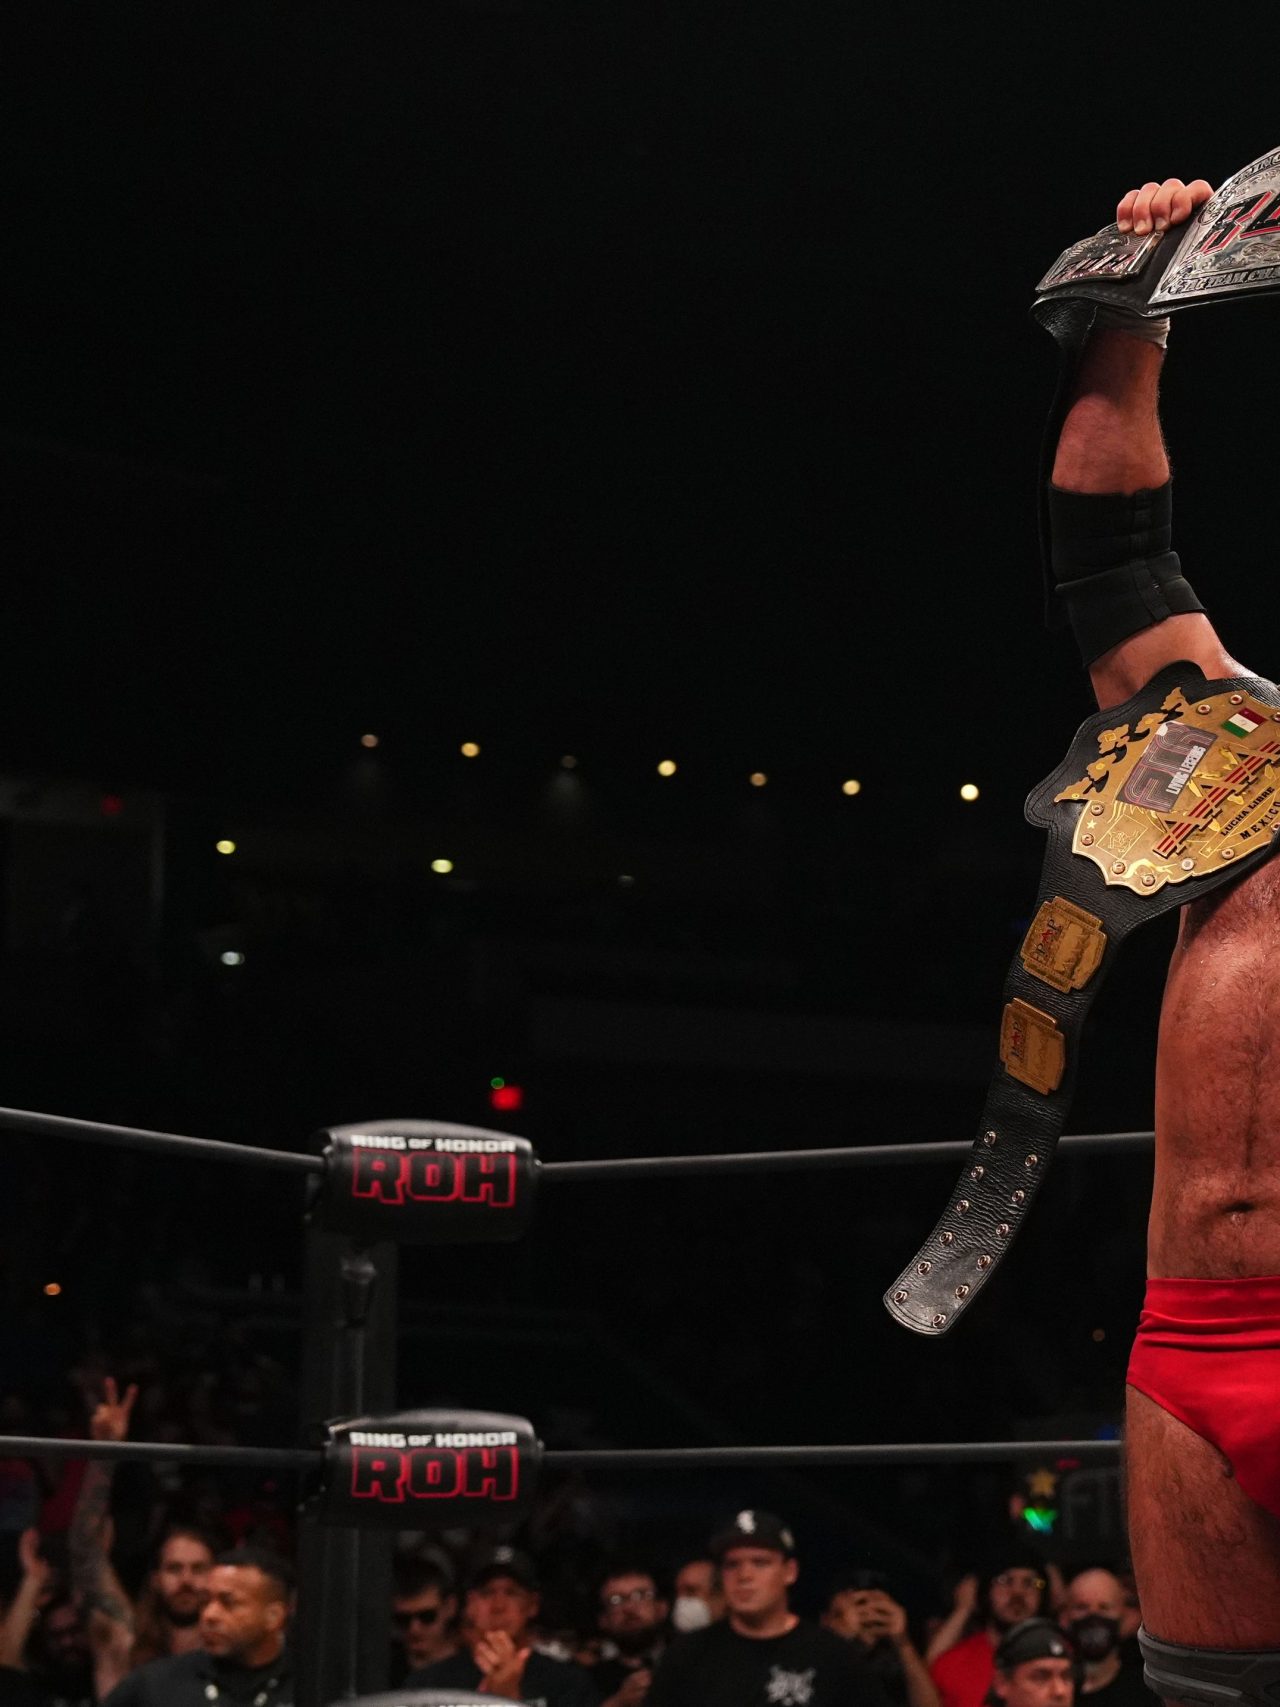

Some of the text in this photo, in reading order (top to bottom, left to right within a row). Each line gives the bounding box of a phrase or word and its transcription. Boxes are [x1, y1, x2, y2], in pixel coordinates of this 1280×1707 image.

[1220, 786, 1276, 837] LUCHA LIBRE
[351, 1134, 516, 1153] RING OF HONOR
[352, 1149, 516, 1207] ROH
[350, 1431, 517, 1448] RING OF HONOR
[352, 1448, 518, 1502] ROH
